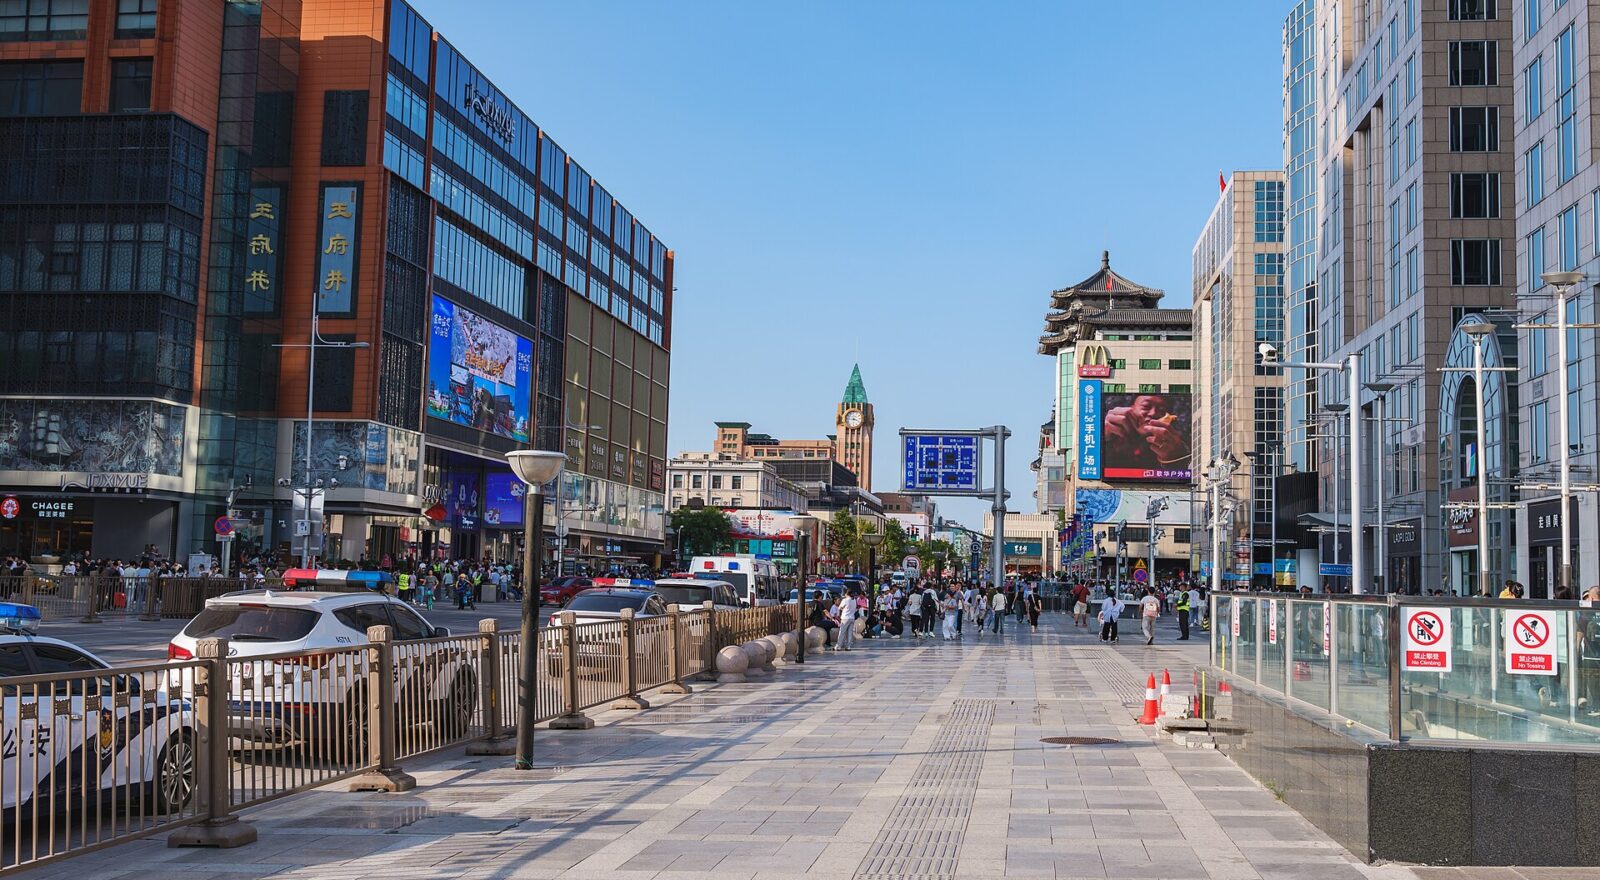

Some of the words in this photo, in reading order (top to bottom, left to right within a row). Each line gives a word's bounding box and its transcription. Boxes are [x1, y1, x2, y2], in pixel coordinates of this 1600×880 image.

[325, 202, 352, 292] 王府井
[1084, 424, 1095, 465] 手机广场
[32, 502, 74, 510] CHAGEE
[1519, 655, 1545, 663] 禁止抛物
[3, 724, 50, 759] 公安
